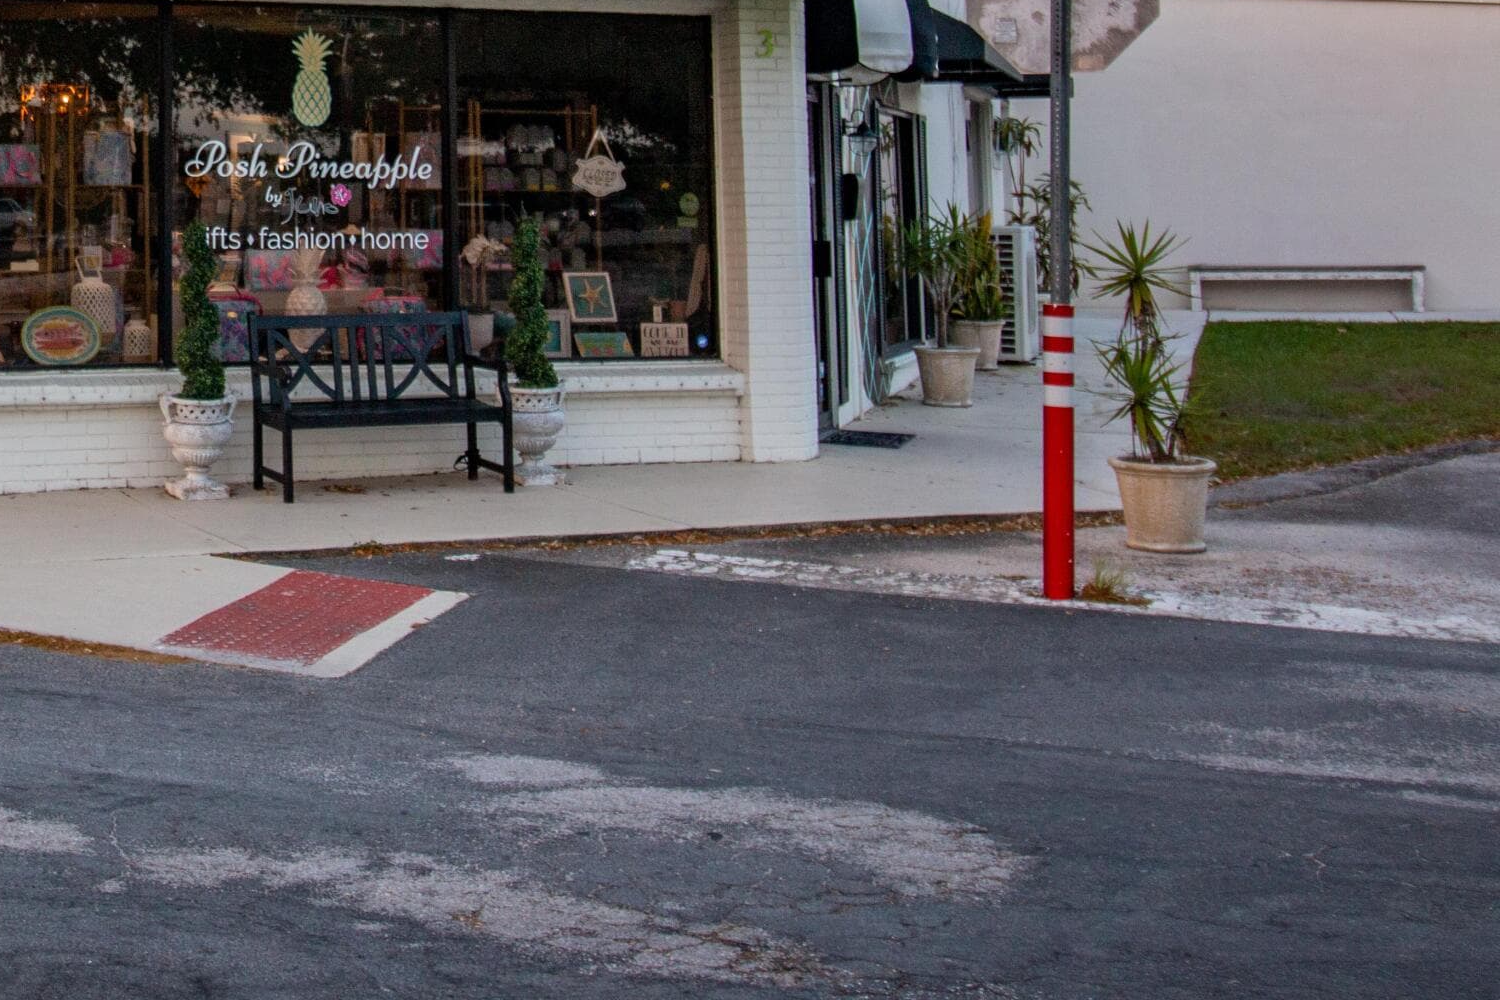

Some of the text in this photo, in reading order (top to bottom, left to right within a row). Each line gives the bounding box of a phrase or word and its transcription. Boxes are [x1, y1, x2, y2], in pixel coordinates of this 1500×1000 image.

[185, 140, 432, 189] Posh Pineapple
[265, 185, 283, 208] by
[206, 227, 429, 250] ifts fashion home
